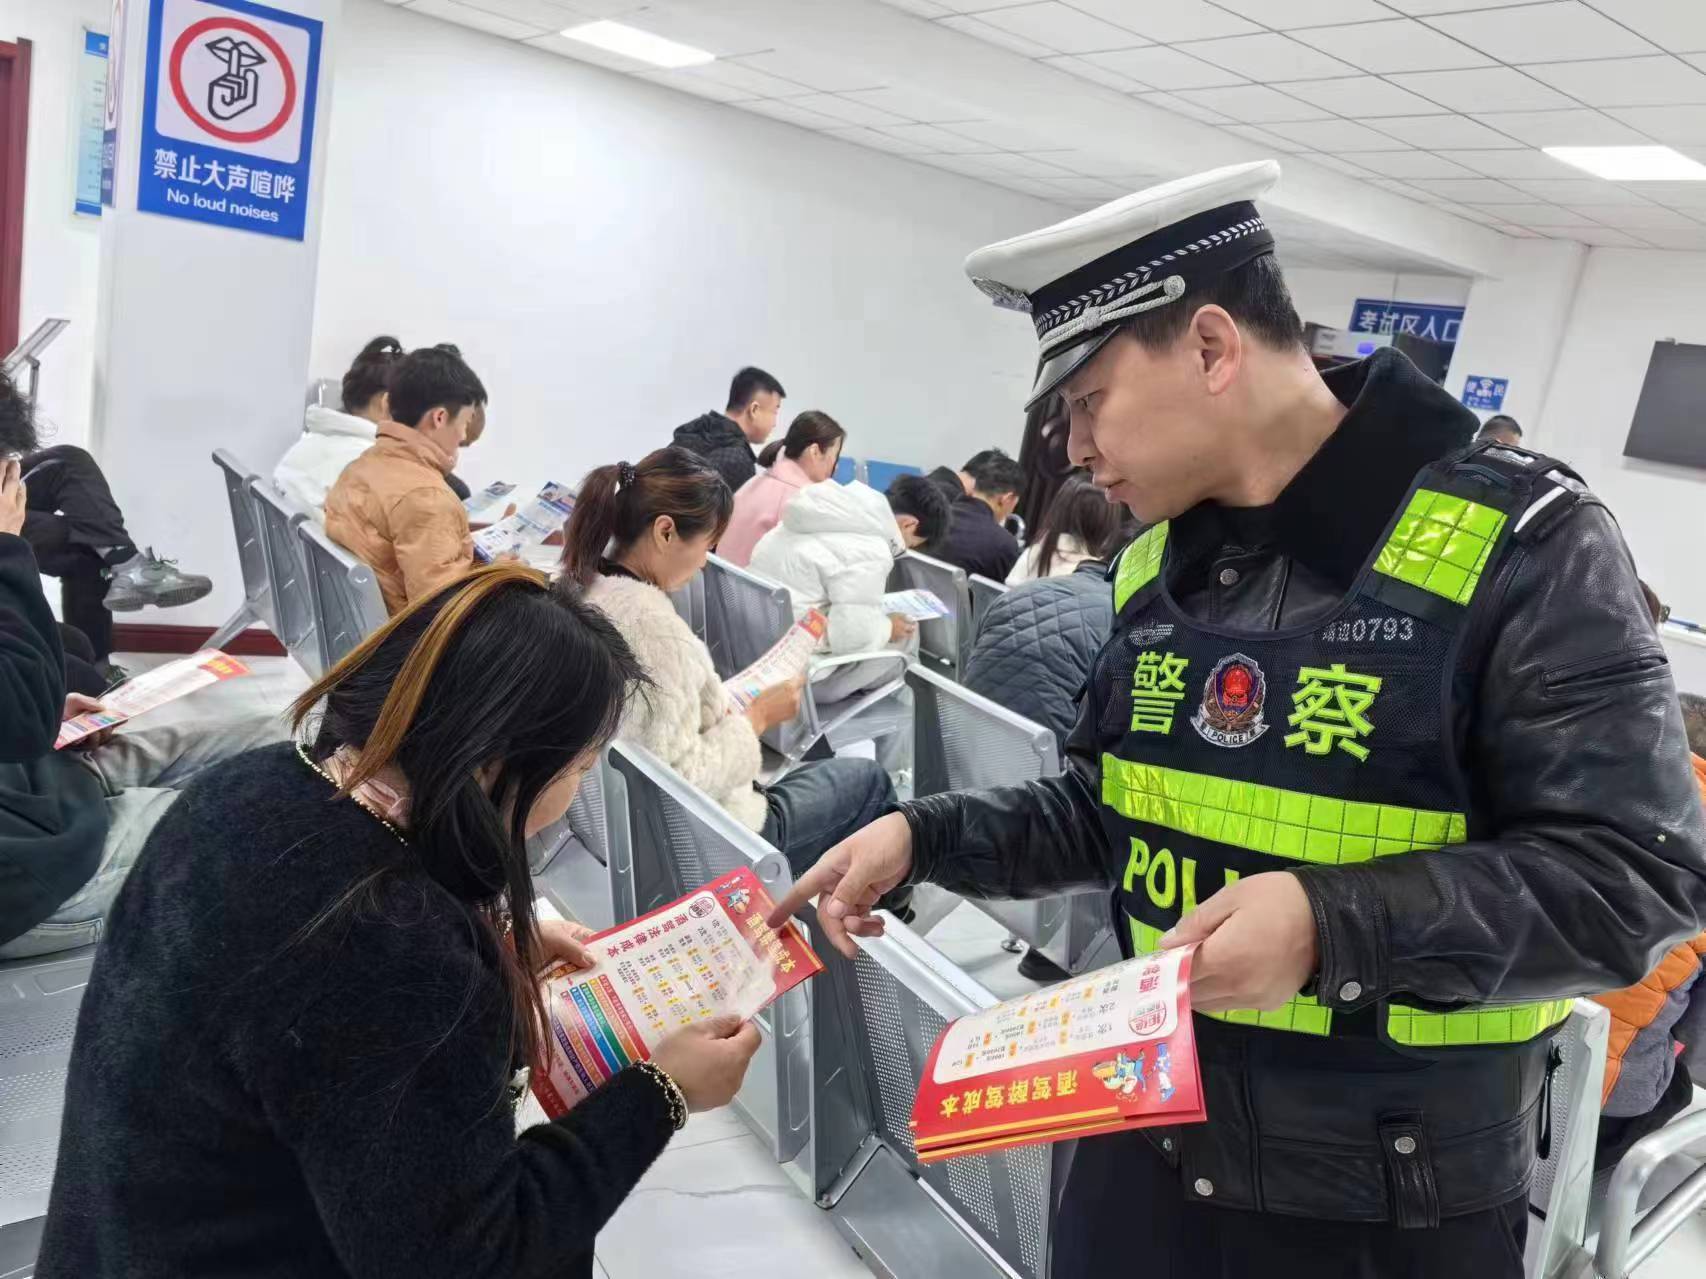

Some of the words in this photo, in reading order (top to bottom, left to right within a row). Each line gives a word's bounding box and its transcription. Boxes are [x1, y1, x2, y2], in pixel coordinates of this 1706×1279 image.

[153, 147, 296, 204] 禁止大声喧哗
[166, 187, 190, 205] No
[193, 192, 226, 213] loud
[229, 203, 280, 223] noises
[1322, 617, 1414, 642] 0793
[1131, 651, 1189, 735] 警
[1284, 663, 1383, 762] 察
[1211, 730, 1244, 744] POLICE
[1122, 836, 1240, 915] POL
[940, 1069, 1080, 1118] 酒驾醉驾成本
